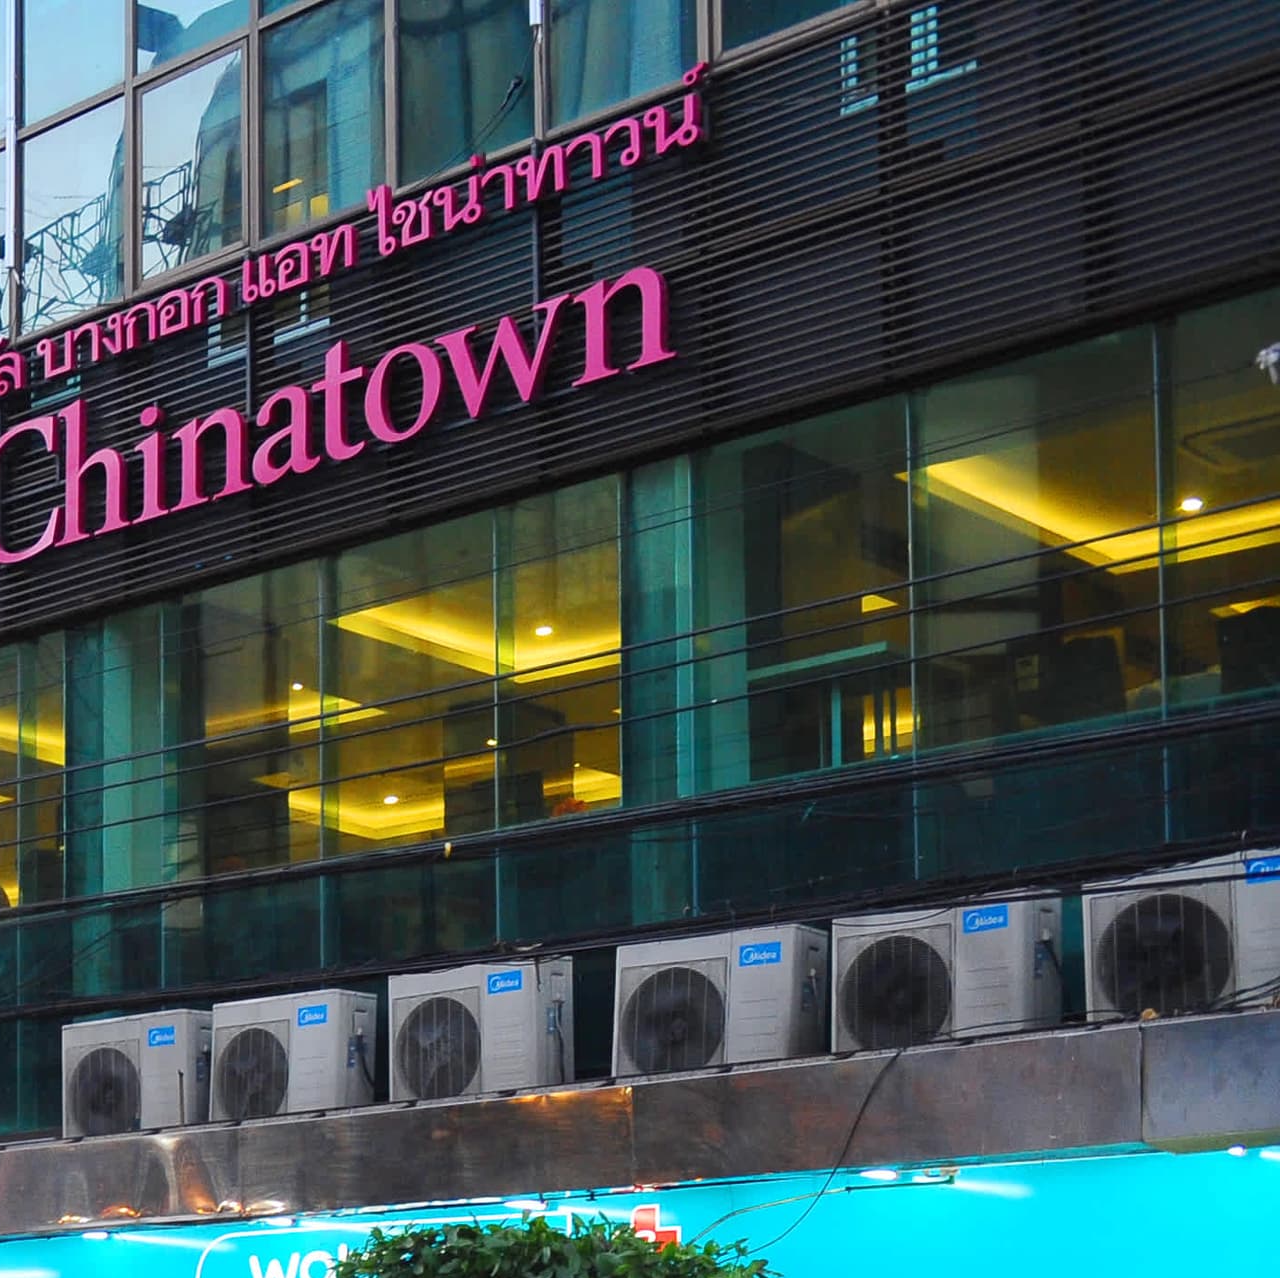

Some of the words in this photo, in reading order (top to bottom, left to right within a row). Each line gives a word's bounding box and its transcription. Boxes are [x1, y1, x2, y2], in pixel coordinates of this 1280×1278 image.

[35, 273, 228, 380] บางกอก
[241, 222, 358, 308] แอท
